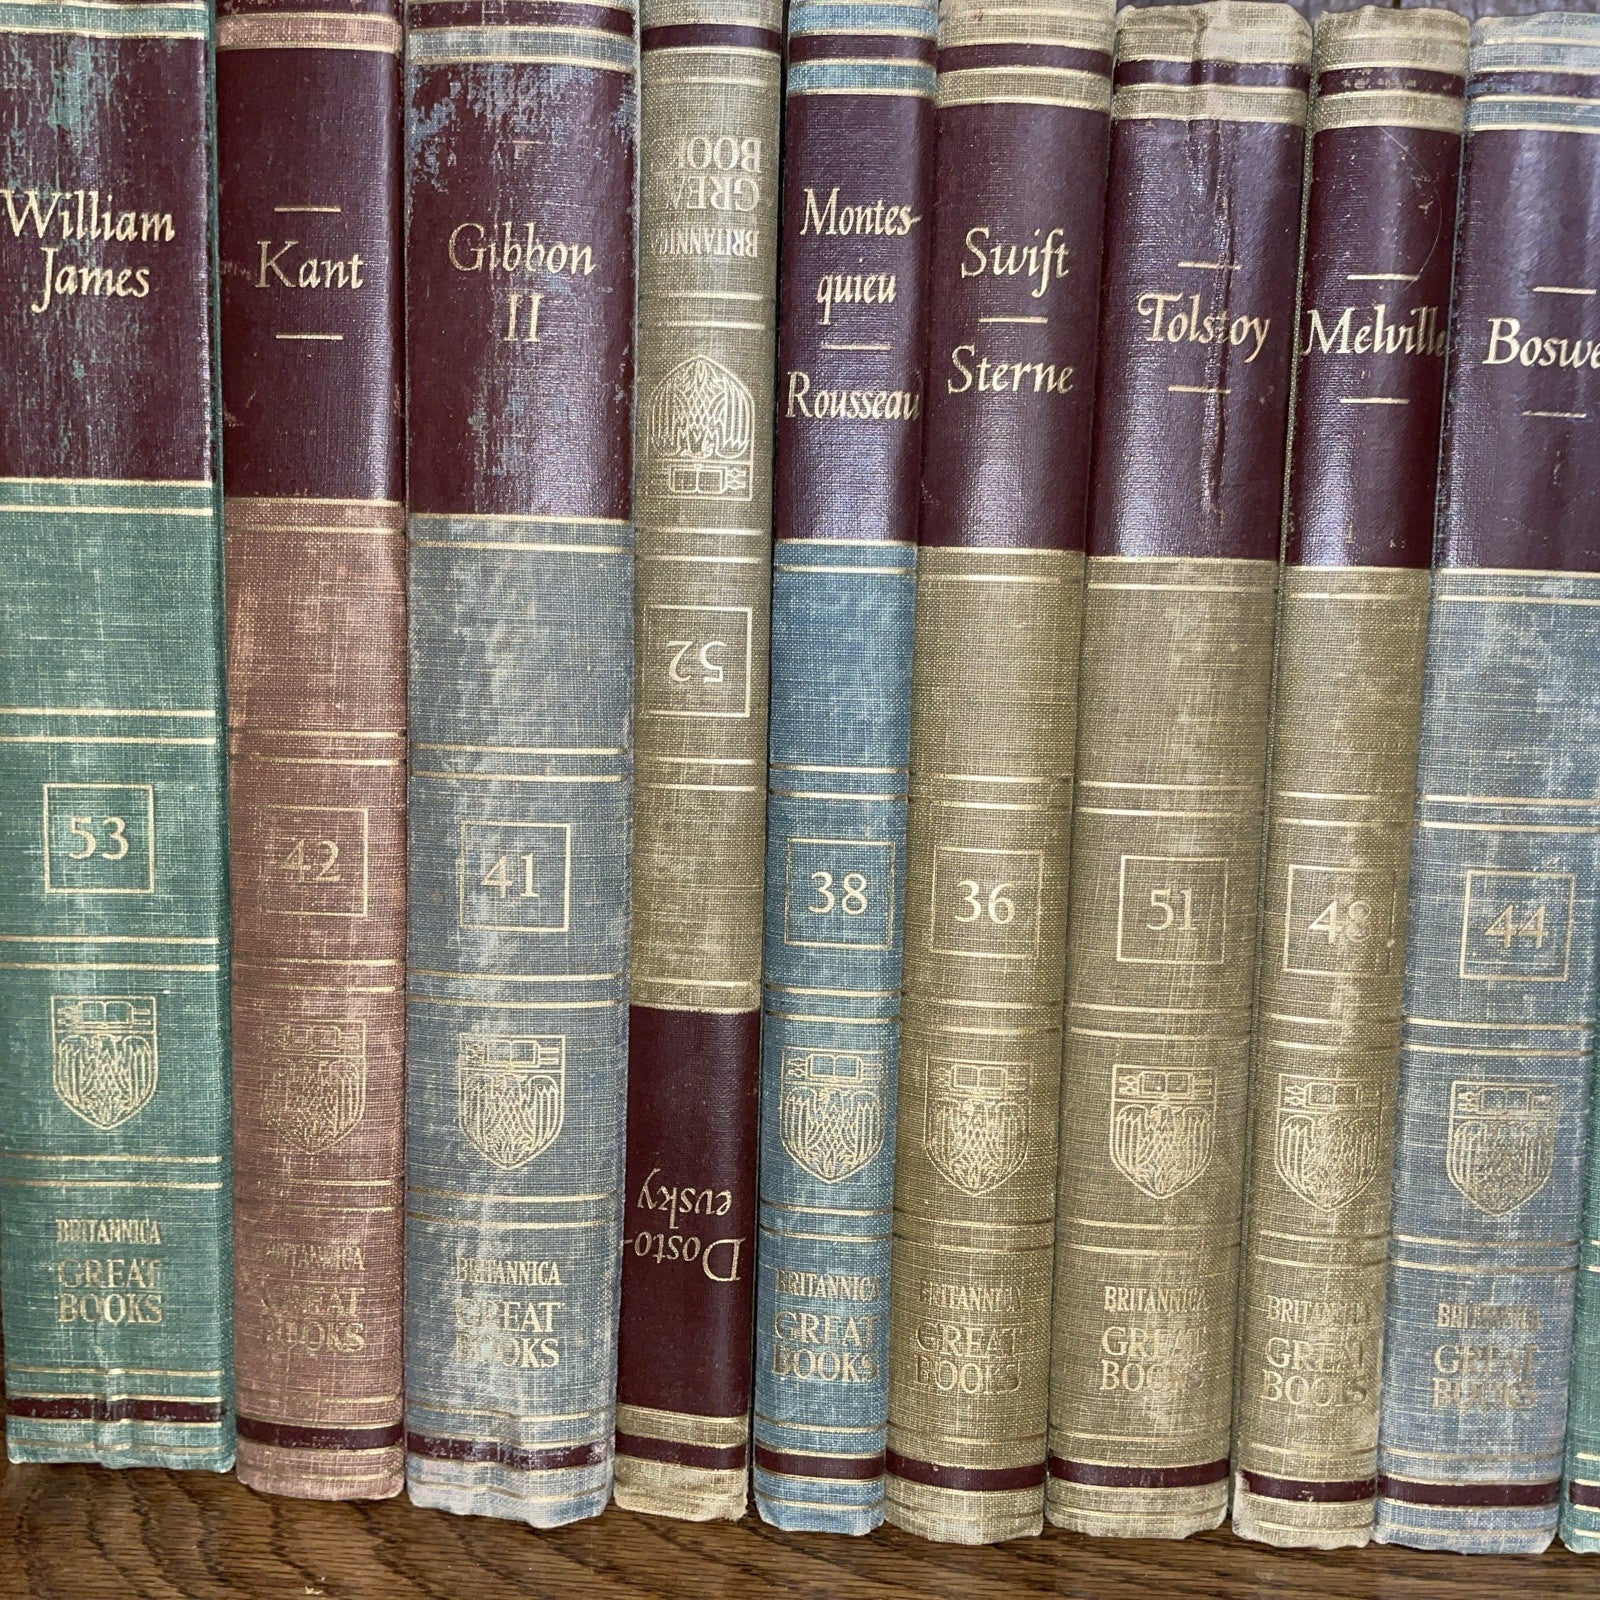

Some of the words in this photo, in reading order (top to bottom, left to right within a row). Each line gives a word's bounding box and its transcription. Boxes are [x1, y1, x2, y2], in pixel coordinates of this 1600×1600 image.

[650, 136, 762, 173] BOOK
[0, 189, 175, 242] William
[648, 176, 760, 211] GREA
[799, 187, 921, 236] Montes-
[255, 240, 364, 290] Kant
[448, 222, 597, 275] Gibbon
[960, 227, 1069, 298] Swift
[31, 246, 150, 313] James
[816, 257, 897, 325] quieu
[503, 292, 545, 342] II
[1138, 292, 1271, 364] Tolstoy
[1302, 303, 1446, 358] Melville
[947, 344, 1078, 395] Sterne
[785, 371, 921, 421] Rousseau
[665, 640, 727, 684] 52
[68, 816, 129, 861] 53
[280, 838, 343, 884] 42
[480, 853, 540, 899] 41
[808, 871, 868, 916] 38
[954, 880, 1016, 925] 36
[1145, 888, 1197, 931] 51
[1308, 900, 1372, 944] 48
[1485, 903, 1548, 949] 44
[637, 1167, 732, 1229] eusky
[54, 1217, 163, 1245] BRITANNICA
[57, 1258, 163, 1290] GREAT
[455, 1256, 563, 1286] BRITANNICA
[623, 1231, 746, 1281] Dosto-
[775, 1269, 880, 1300] BRITANNICA
[58, 1293, 163, 1324] BOOKS
[455, 1298, 561, 1333] GREAT
[774, 1310, 880, 1347] GREAT
[916, 1321, 1023, 1358] GREAT
[772, 1343, 879, 1383] BOOKS
